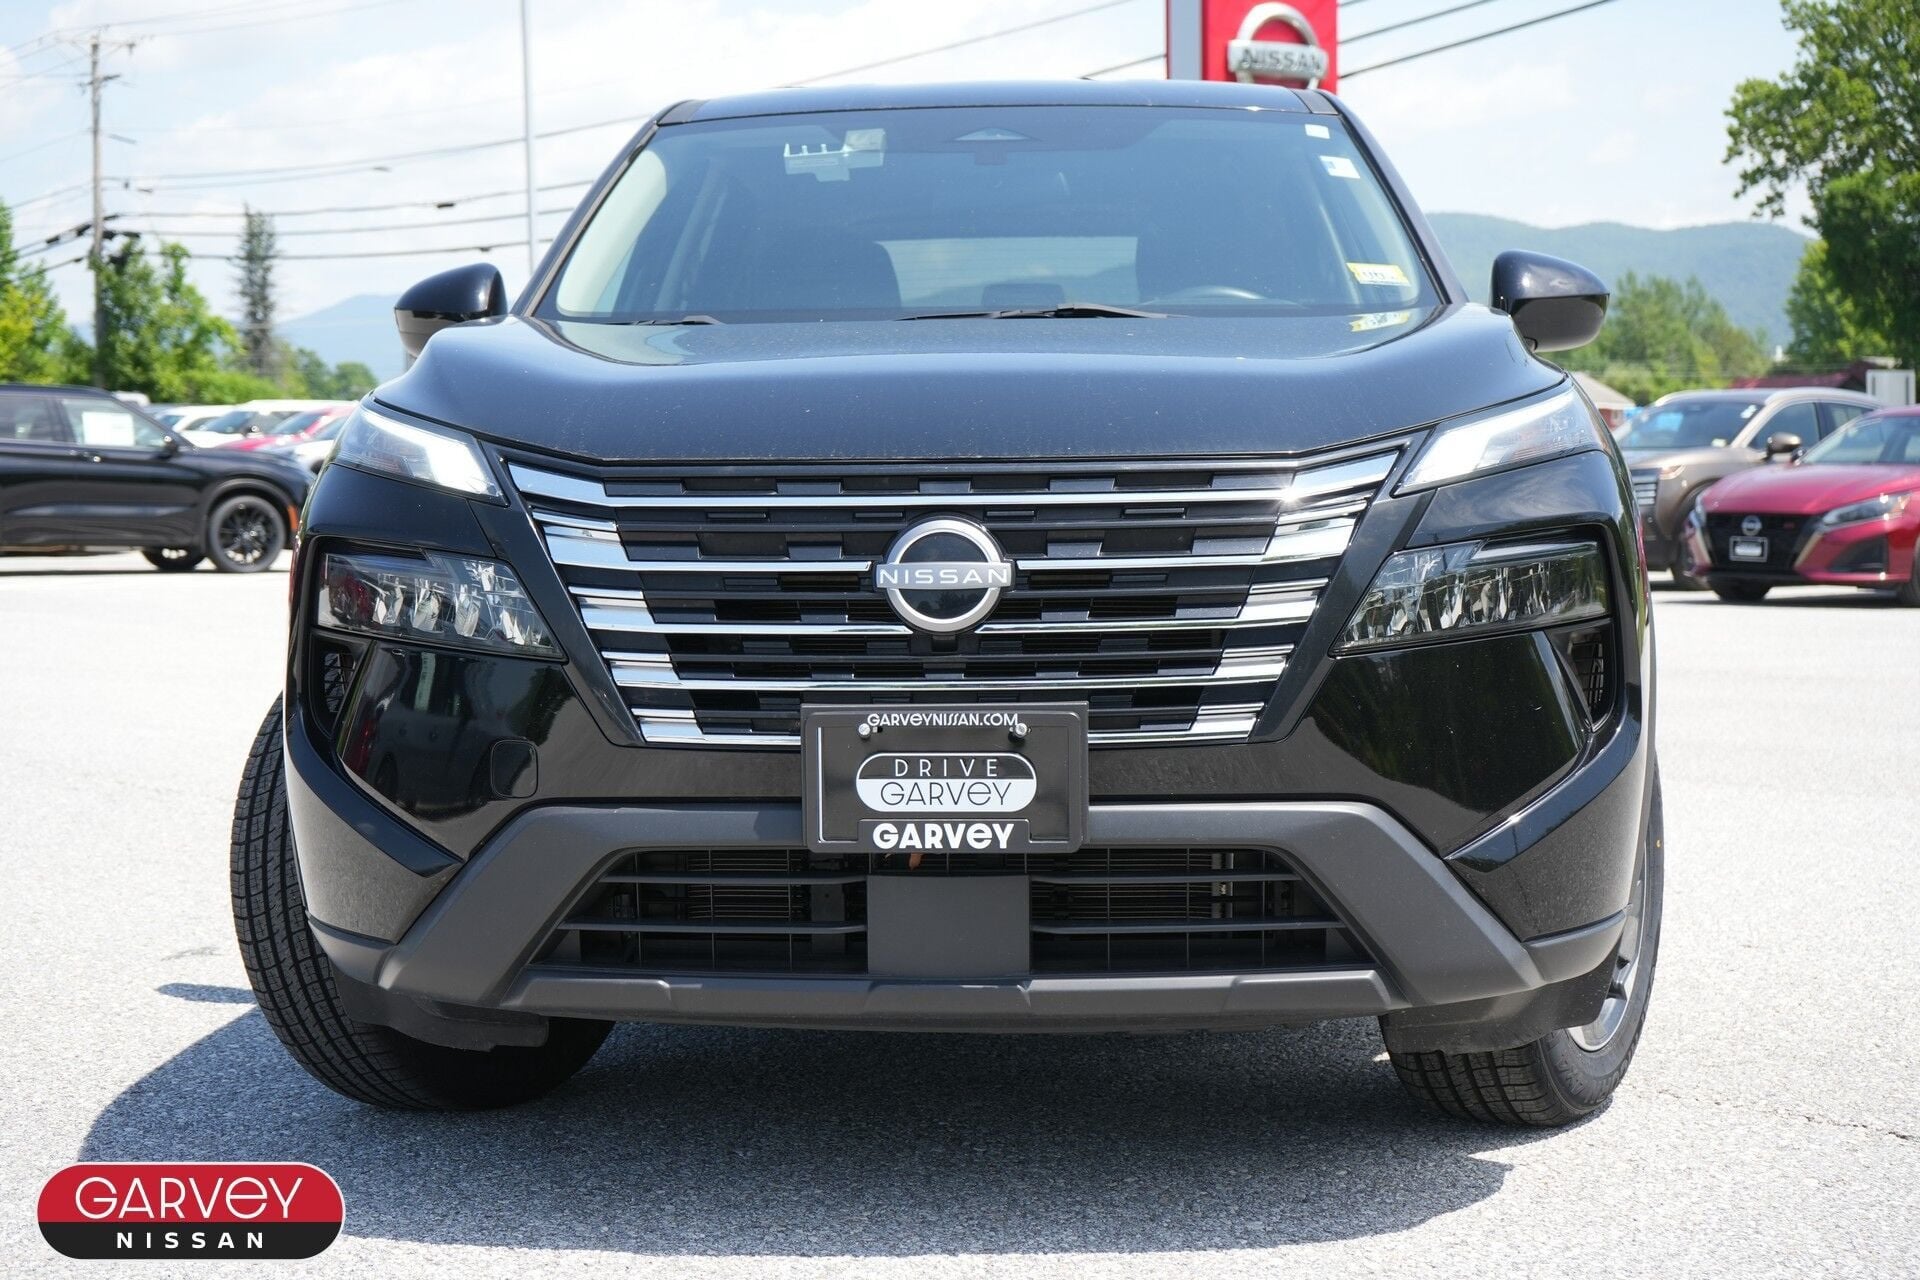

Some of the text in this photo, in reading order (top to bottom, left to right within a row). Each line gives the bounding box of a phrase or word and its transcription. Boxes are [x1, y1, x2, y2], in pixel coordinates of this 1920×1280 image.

[1239, 48, 1322, 70] NISSAN
[879, 568, 1009, 585] NISSAN
[895, 758, 998, 777] DRIVE
